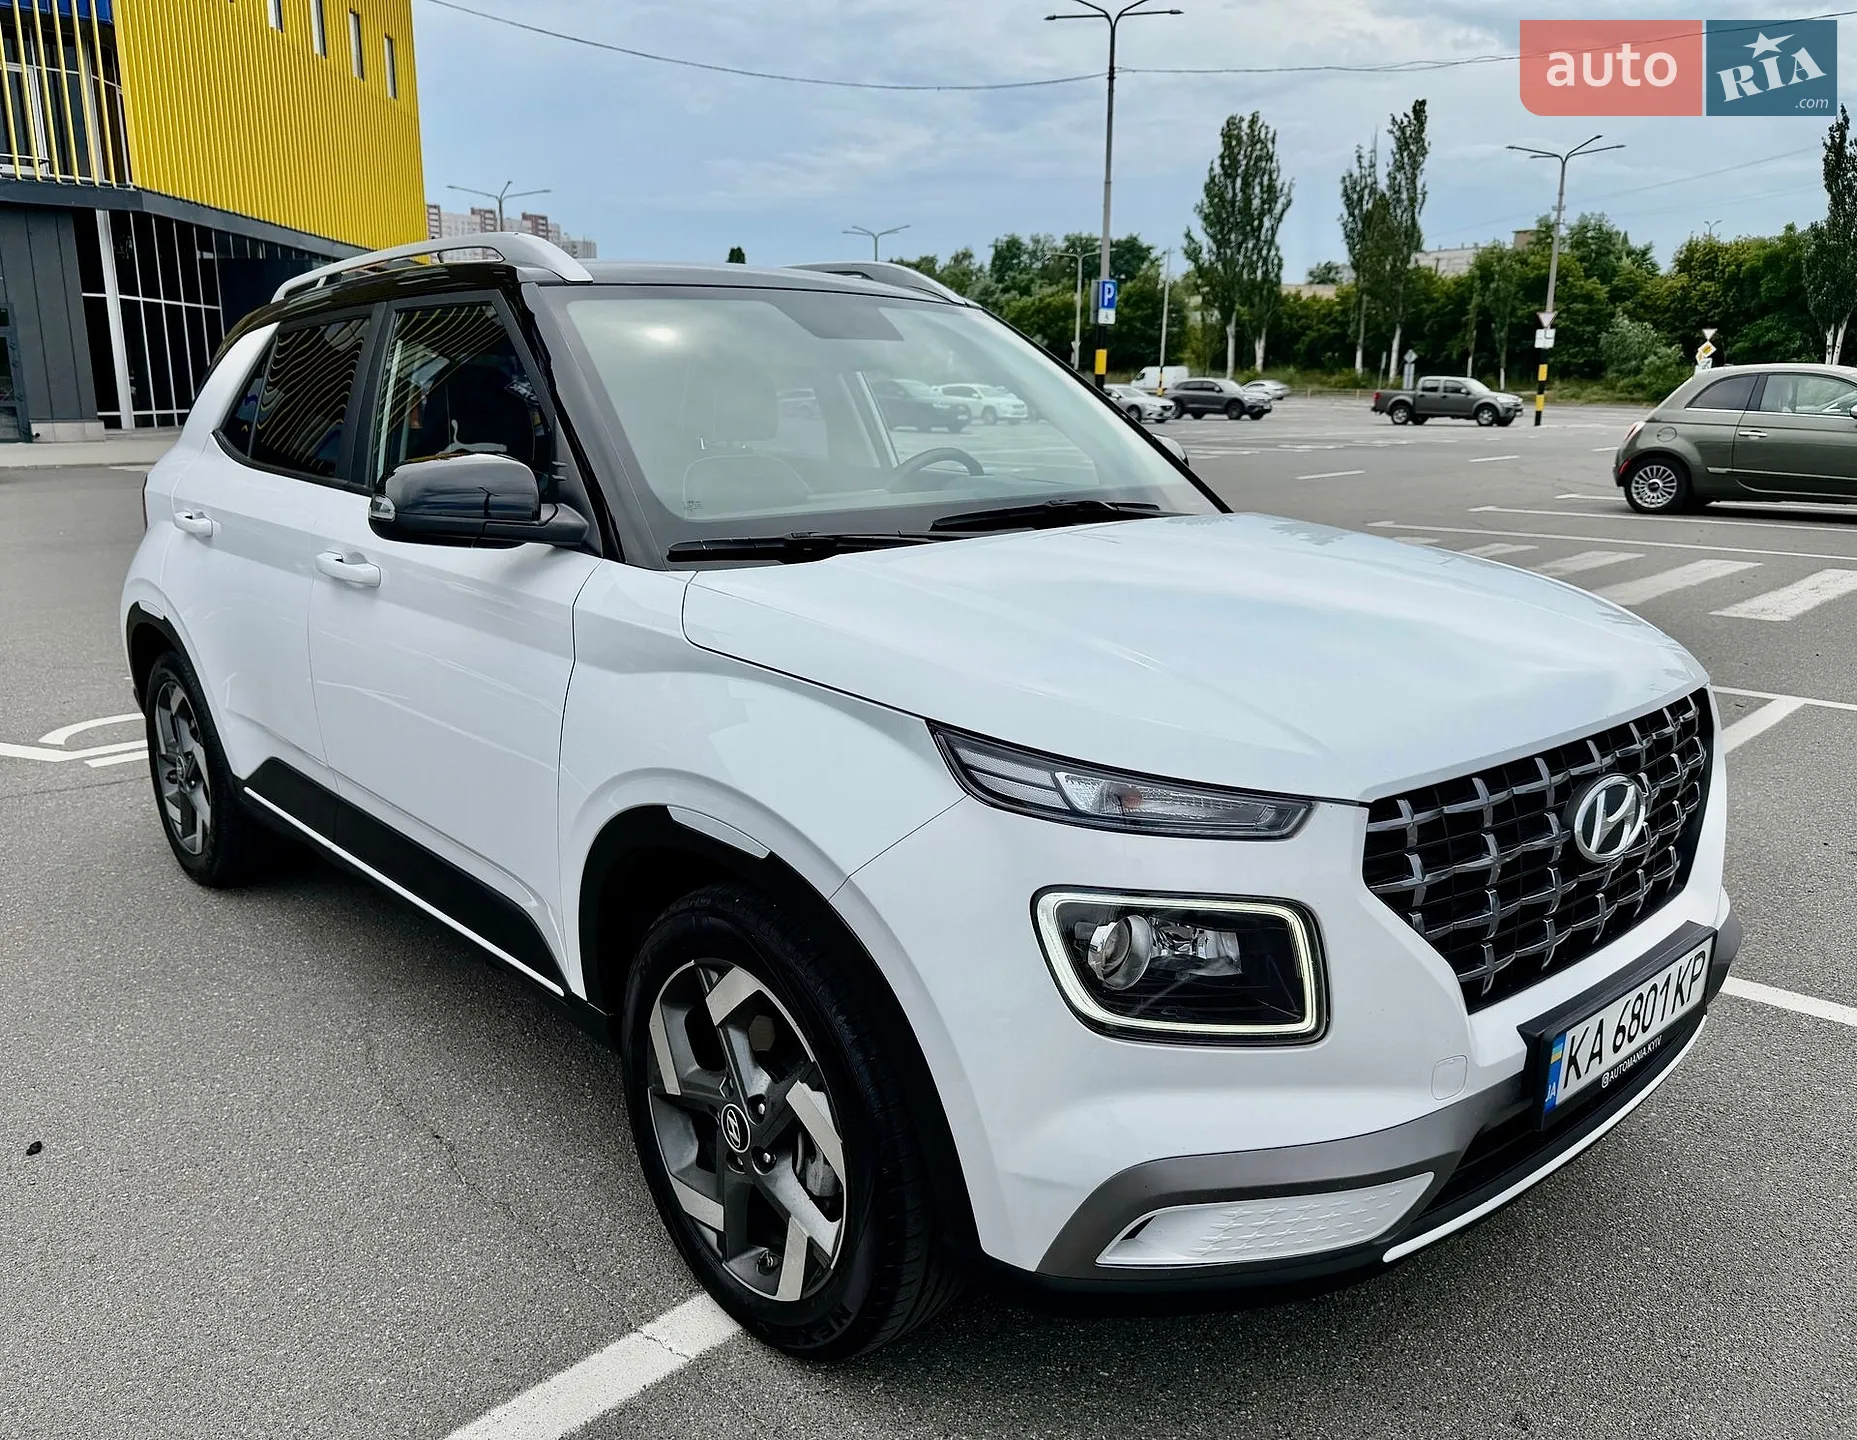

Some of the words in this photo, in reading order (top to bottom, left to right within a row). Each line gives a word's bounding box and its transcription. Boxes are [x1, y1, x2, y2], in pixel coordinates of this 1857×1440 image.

[1104, 283, 1115, 306] P
[1563, 1018, 1604, 1089] KA
[1612, 973, 1672, 1053] 6801
[1671, 949, 1706, 1014] KP
